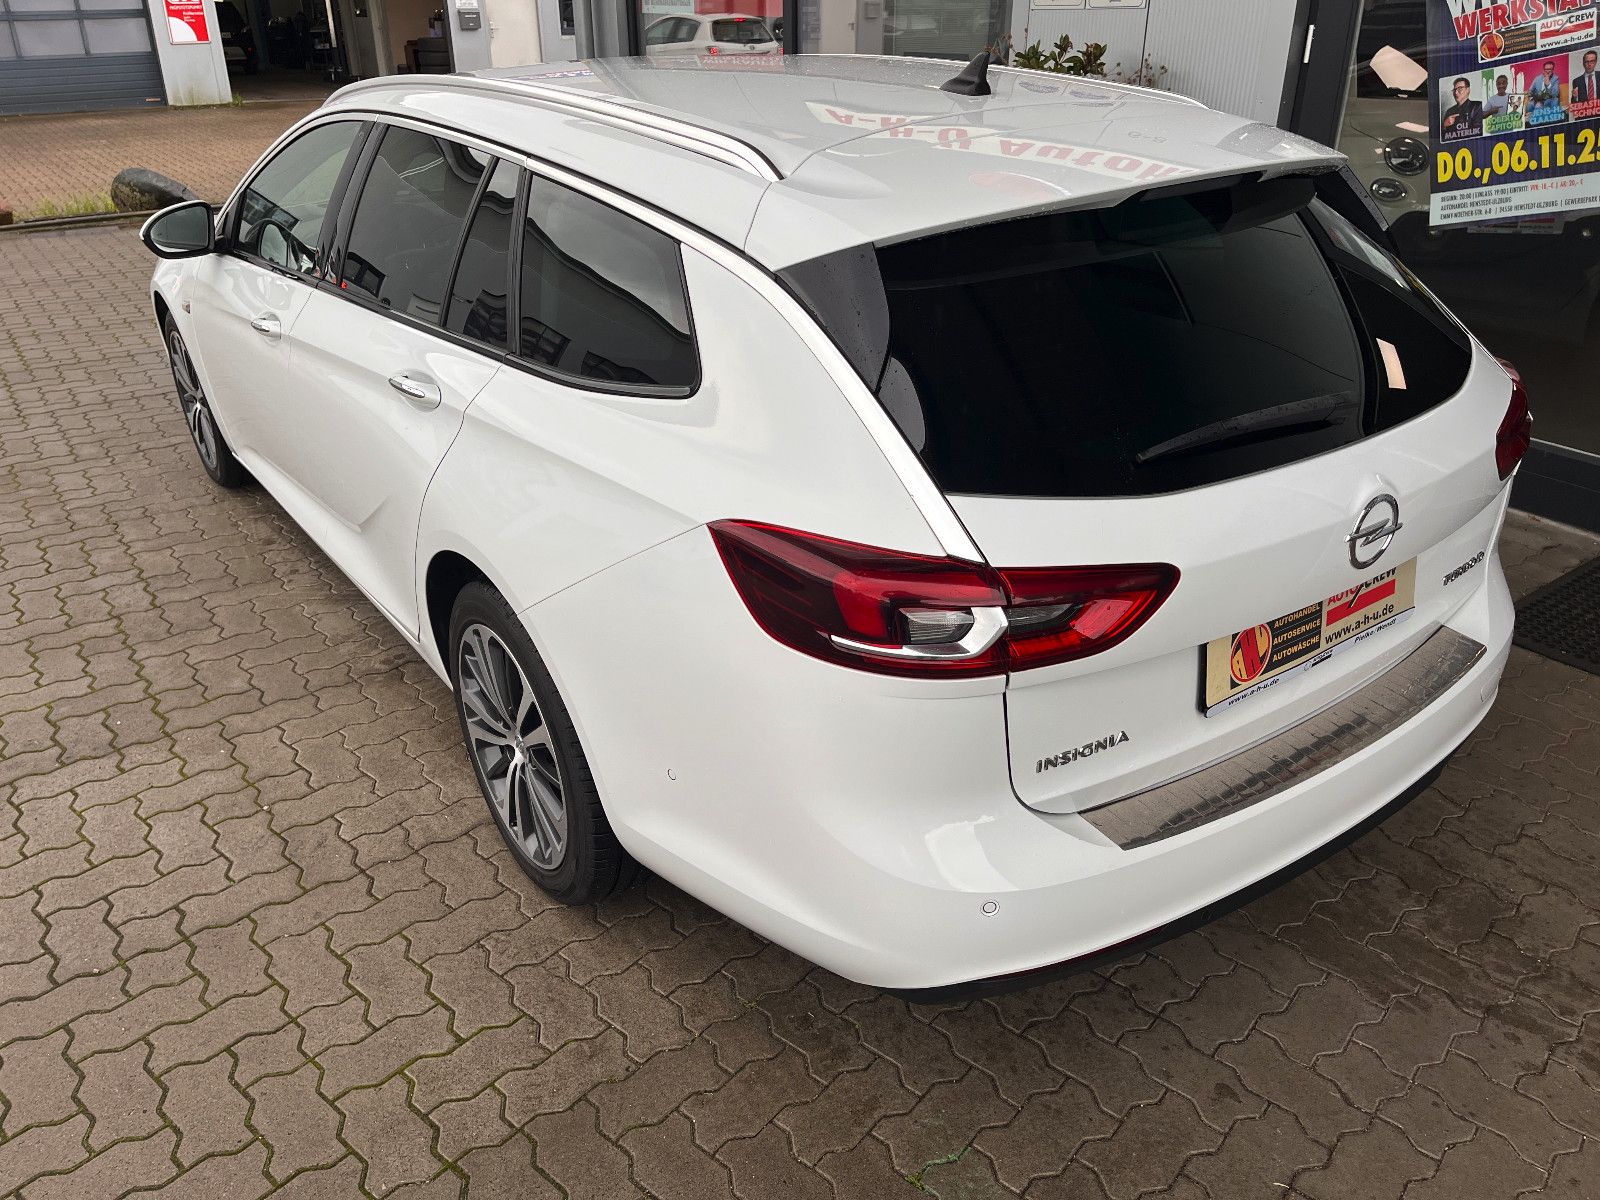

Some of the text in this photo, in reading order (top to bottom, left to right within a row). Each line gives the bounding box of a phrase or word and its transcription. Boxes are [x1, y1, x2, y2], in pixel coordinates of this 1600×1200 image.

[1453, 0, 1600, 40] WERKSTA
[1568, 11, 1594, 23] CREW
[1540, 33, 1594, 48] www.a-h-u.de
[1273, 603, 1320, 629] AUTOHANDEL
[1324, 603, 1395, 645] www.a-h-u.de
[1273, 618, 1321, 646] AUTOSERVICE
[1035, 730, 1130, 773] INSIGNIA
